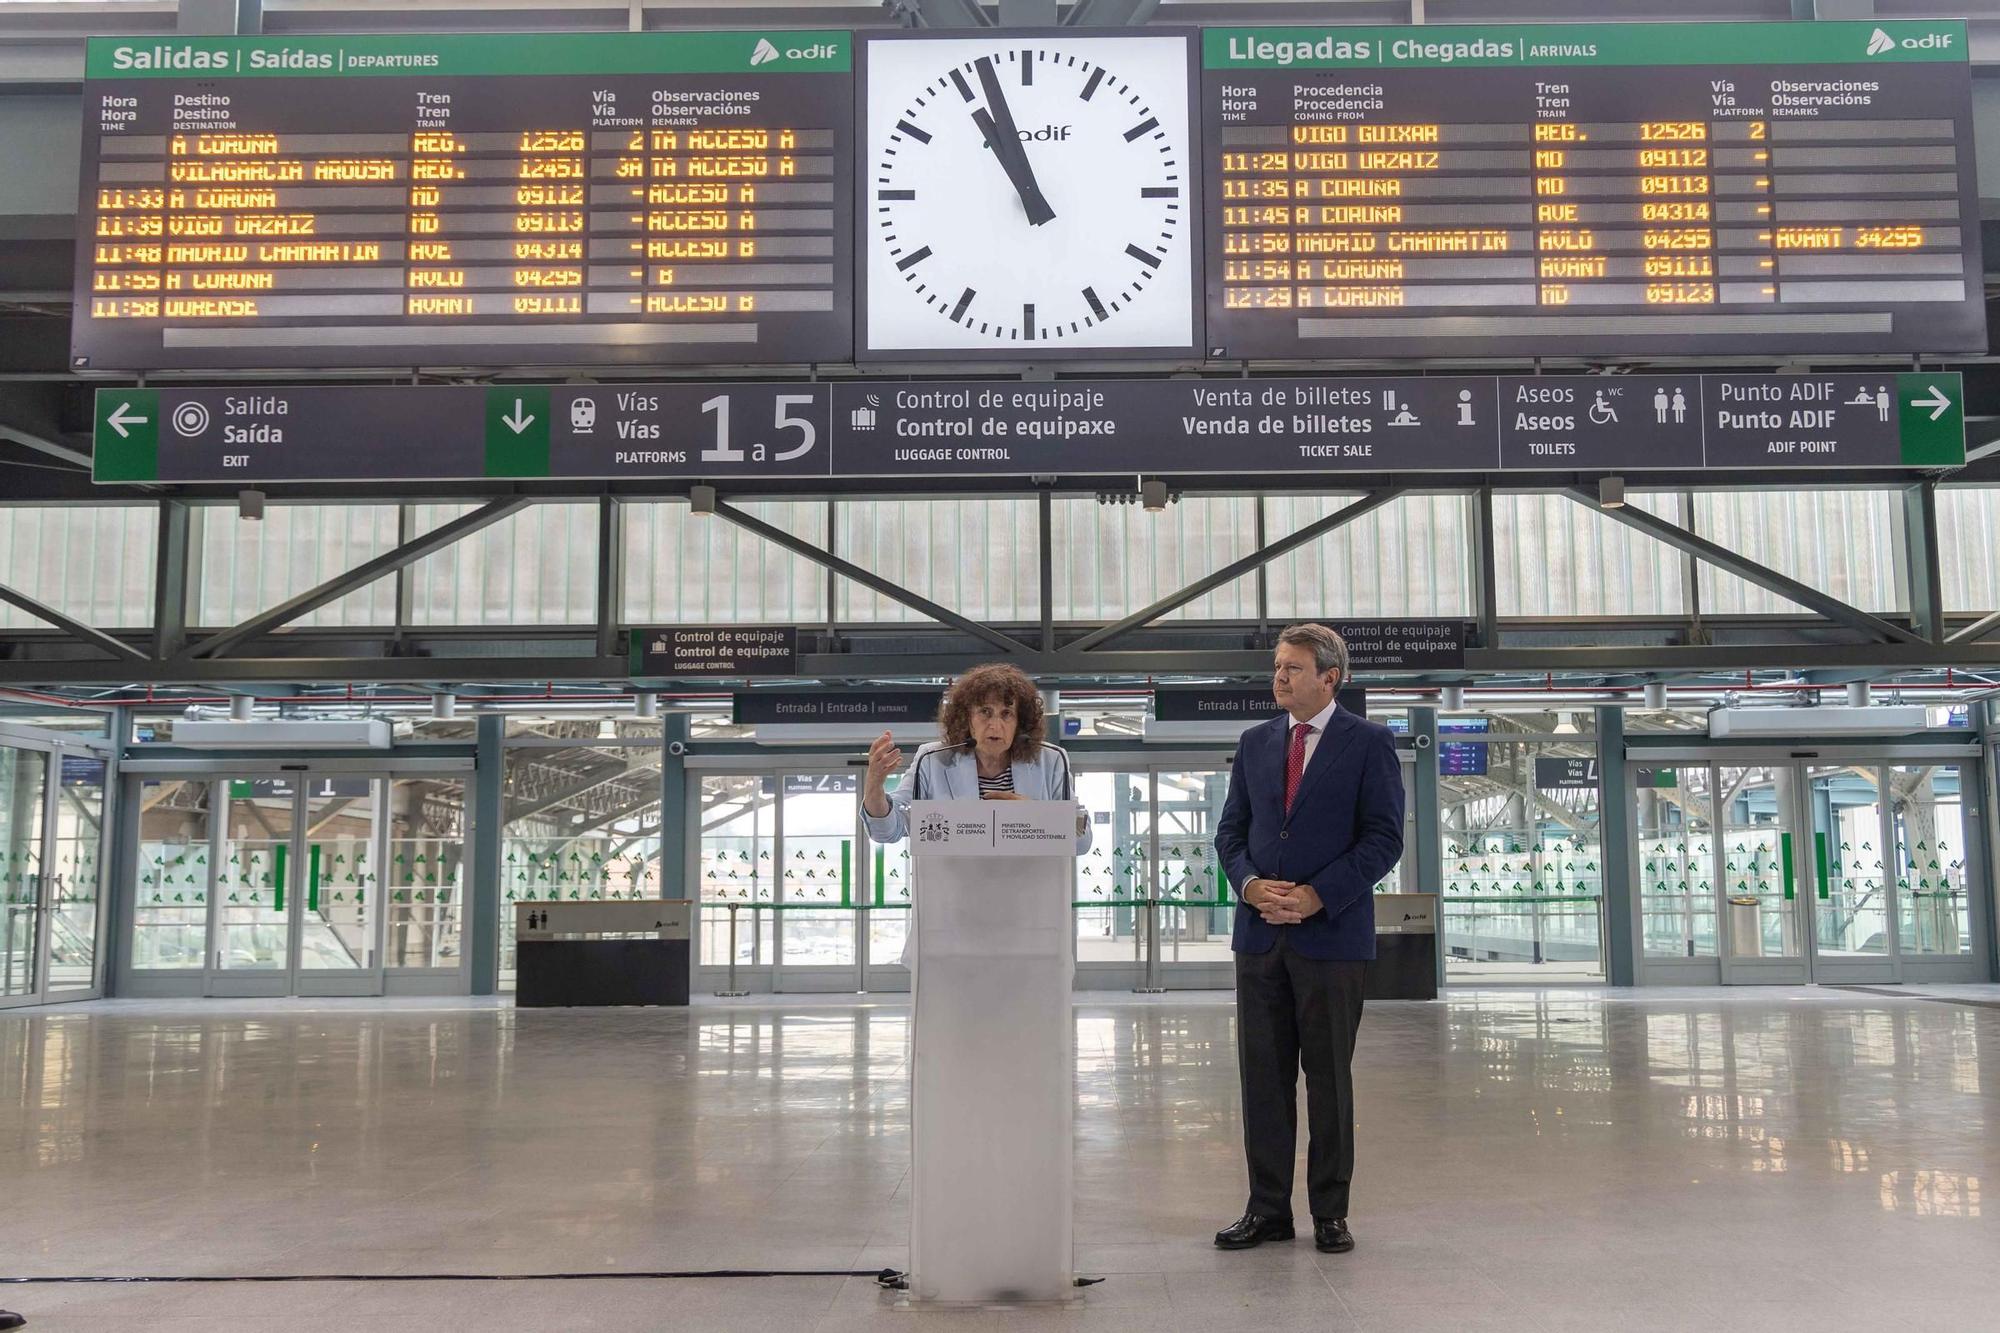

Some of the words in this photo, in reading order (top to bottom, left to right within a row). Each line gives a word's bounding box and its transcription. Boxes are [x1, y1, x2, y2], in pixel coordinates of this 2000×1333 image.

[1902, 34, 1952, 48] adif
[113, 47, 229, 70] Salidas
[250, 49, 332, 70] Saídas
[348, 55, 439, 68] DEPARTURES
[786, 44, 838, 59] adif
[1229, 38, 1370, 64] Llegadas
[1392, 40, 1512, 62] Chegadas
[1530, 44, 1596, 57] ARRIVALS
[1222, 86, 1256, 97] Hora
[1294, 86, 1382, 96] Procedencia
[1536, 83, 1569, 93] Tren
[1712, 81, 1735, 92] Vía
[1771, 80, 1879, 92] Observaciones
[103, 96, 137, 107] Hora
[175, 94, 230, 106] Destino
[417, 93, 450, 104] Tren
[593, 91, 616, 102] Vía
[652, 90, 759, 102] Observaciones
[1222, 100, 1257, 110] Hora
[1294, 99, 1383, 109] Procedencia
[1536, 97, 1570, 107] Tren
[1712, 95, 1735, 106] Vía
[1772, 94, 1871, 105] Observacións
[102, 110, 136, 120] Hora
[174, 108, 229, 119] Destino
[417, 106, 450, 117] Tren
[593, 105, 616, 116] Vía
[652, 104, 751, 116] Observacións
[652, 118, 698, 126] REMARKS
[1016, 125, 1073, 141] adif
[1294, 126, 1346, 143] VIGO
[1359, 126, 1438, 143] GUIXAR
[1536, 124, 1587, 140] REG.
[1641, 123, 1705, 140] 12526
[1750, 123, 1765, 139] 2
[1223, 154, 1288, 171] 11:29
[1294, 153, 1347, 170] VIGO
[1360, 152, 1438, 169] URZAIZ
[1537, 151, 1563, 167] MD
[1640, 150, 1706, 166] 09112
[1224, 181, 1288, 198] 11:35
[1296, 181, 1308, 196] A
[1322, 180, 1400, 196] CORUÑA
[1538, 178, 1563, 194] MD
[1642, 177, 1707, 193] 09113
[1225, 208, 1289, 224] 11:45
[1296, 208, 1309, 223] A
[1322, 207, 1401, 223] CORUÑA
[1539, 205, 1578, 221] AVE
[1643, 203, 1709, 220] 04314
[1225, 234, 1289, 253] 11:50
[1193, 388, 1252, 406] Venta
[1262, 388, 1285, 405] de
[1296, 387, 1371, 405] billetes
[1516, 385, 1574, 403] Aseos
[1609, 387, 1624, 396] WC
[1721, 383, 1781, 401] Punto
[1790, 382, 1835, 401] ADIF
[225, 397, 288, 415] Salida
[617, 392, 658, 411] Vías
[896, 391, 969, 408] Control
[979, 391, 1003, 408] de
[1012, 390, 1104, 412] equipaje
[701, 395, 744, 462] 1
[752, 443, 765, 461] a
[775, 394, 816, 461] 5
[896, 418, 973, 437] Control
[982, 418, 1007, 436] de
[1016, 417, 1115, 438] equipaxe
[1182, 416, 1249, 434] Venda
[1258, 416, 1283, 434] de
[1293, 415, 1371, 433] billetes
[1515, 413, 1575, 431] Aseos
[1718, 411, 1782, 429] Punto
[1790, 410, 1836, 428] ADIF
[224, 425, 282, 444] Saída
[616, 419, 660, 439] Vías
[895, 449, 952, 461] LUGGAGE
[957, 448, 1010, 460] CONTROL
[1299, 445, 1339, 457] TICKET
[1343, 445, 1372, 456] SALE
[1529, 443, 1575, 455] TOILETS
[1767, 441, 1795, 453] ADIF
[1800, 441, 1836, 452] POINT
[223, 456, 249, 467] EXIT
[616, 452, 686, 463] PLATFORMS
[675, 632, 714, 642] Control
[718, 631, 732, 641] de
[735, 631, 784, 643] equipaje
[1342, 626, 1380, 636] Control
[1385, 626, 1398, 635] de
[1402, 625, 1450, 637] equipaje
[675, 646, 715, 657] Control
[719, 646, 733, 657] de
[737, 646, 789, 658] equipaxe
[1348, 641, 1382, 651] ontrol
[1387, 641, 1400, 650] de
[1405, 640, 1456, 652] equipaxe
[776, 703, 816, 713] Entrada
[827, 703, 867, 712] Entrada
[1199, 701, 1238, 710] Entrada
[1250, 701, 1280, 710] Entra
